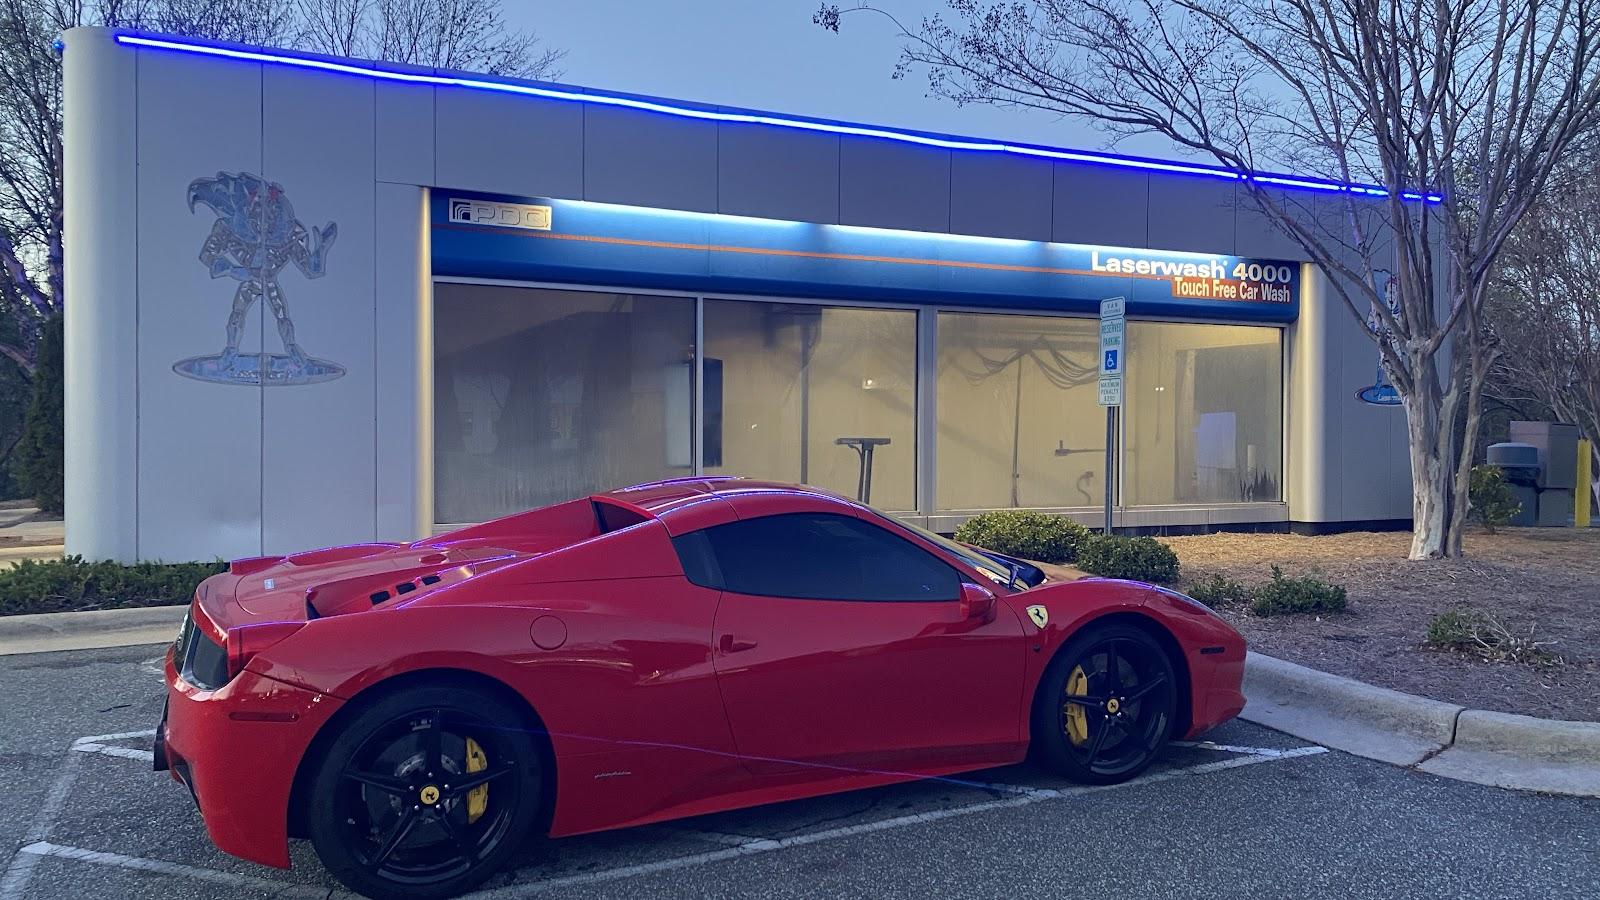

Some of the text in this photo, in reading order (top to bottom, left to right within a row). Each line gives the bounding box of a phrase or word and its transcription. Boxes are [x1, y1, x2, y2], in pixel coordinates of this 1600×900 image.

[1091, 251, 1292, 283] Laserwash 4000
[1174, 277, 1291, 302] Touch Free Car Wash
